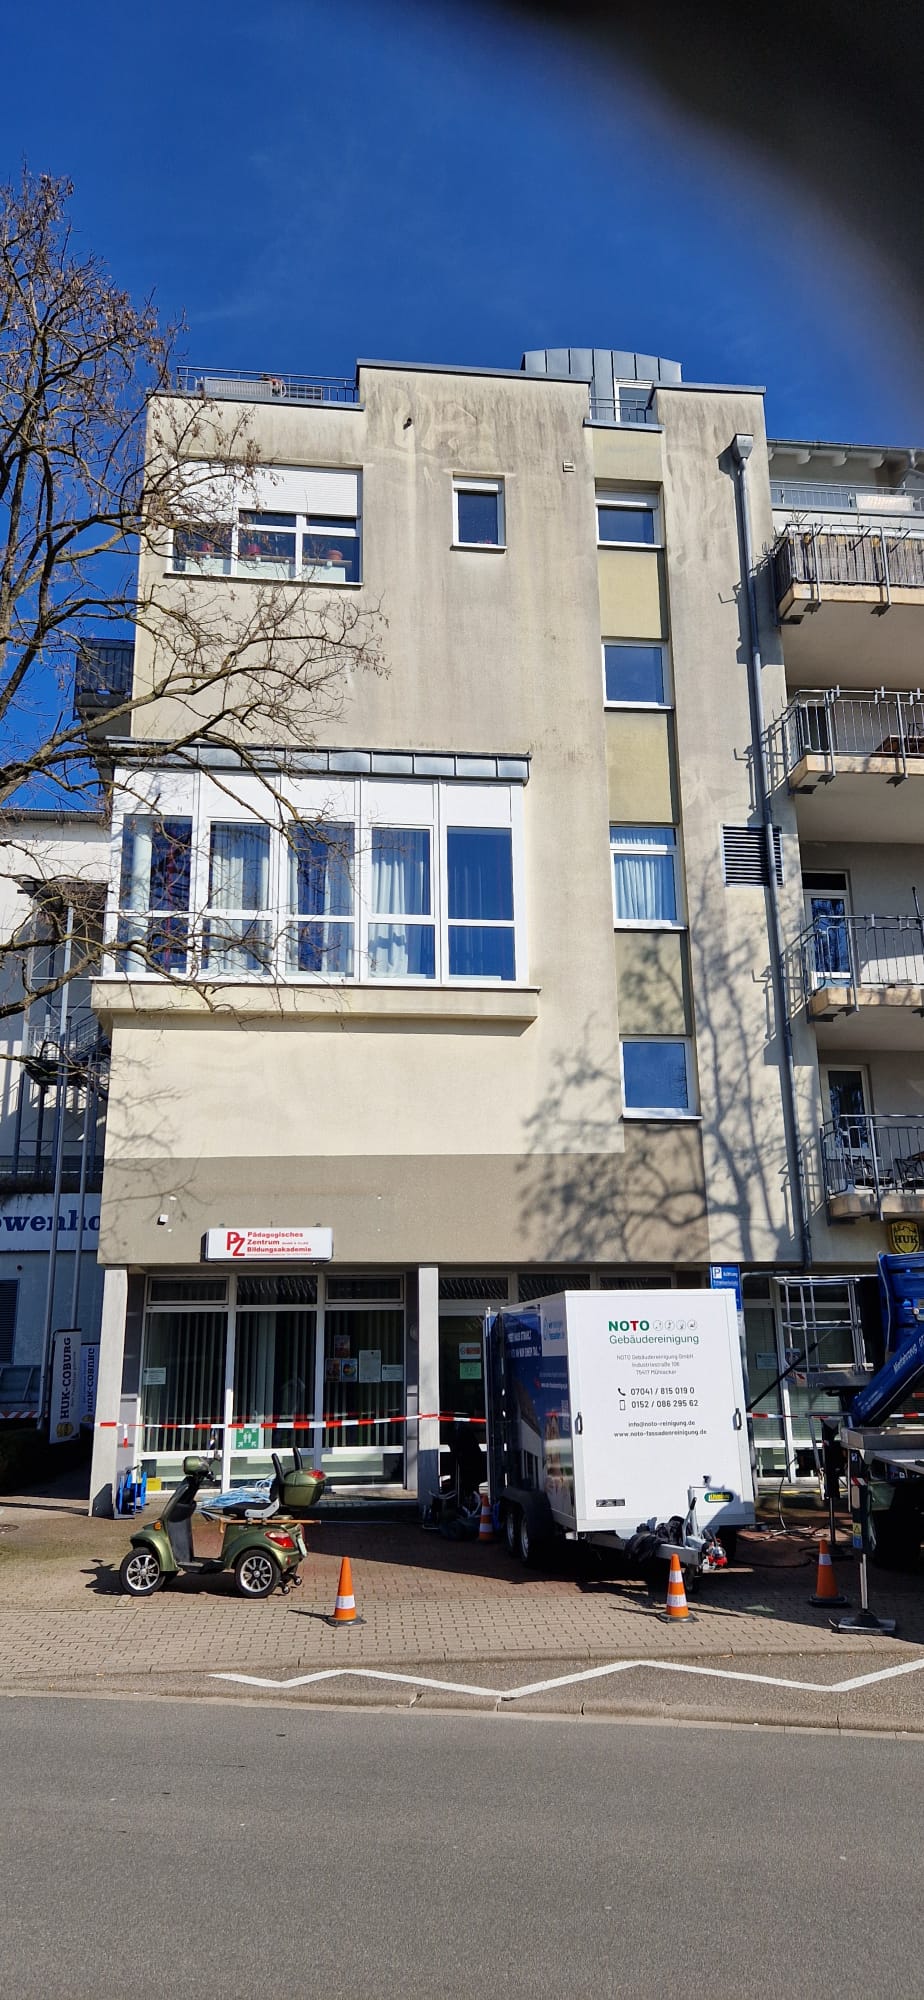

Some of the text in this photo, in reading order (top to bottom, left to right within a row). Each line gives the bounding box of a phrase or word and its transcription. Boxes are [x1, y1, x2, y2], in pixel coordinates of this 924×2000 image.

[0, 1209, 100, 1231] wenho
[247, 1231, 304, 1239] Pädagogisches
[894, 1234, 919, 1244] HUK
[227, 1232, 245, 1256] PZ
[608, 1320, 650, 1331] NOTO
[609, 1334, 699, 1345] Gebäudereinigung
[60, 1337, 71, 1419] HUK-COBURG
[630, 1387, 653, 1396] 07041
[660, 1387, 673, 1395] 815
[675, 1387, 688, 1395] 019
[689, 1386, 695, 1394] 0
[631, 1400, 650, 1409] 0152
[656, 1400, 671, 1408] 086
[673, 1399, 687, 1407] 295
[689, 1399, 699, 1407] 62
[628, 1420, 696, 1428] info@noto-reinigung.de
